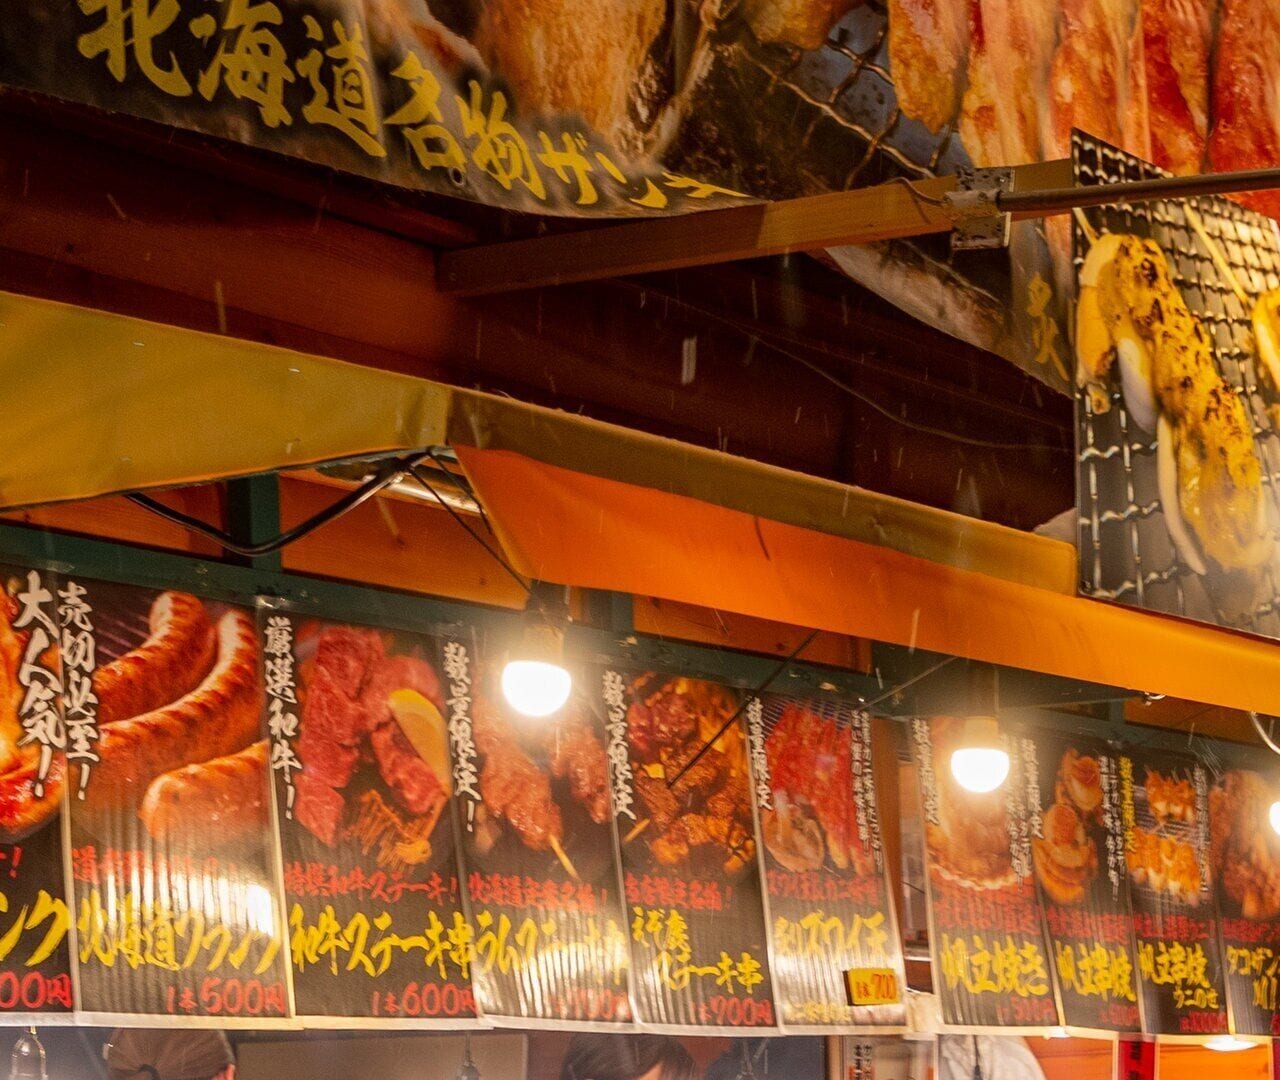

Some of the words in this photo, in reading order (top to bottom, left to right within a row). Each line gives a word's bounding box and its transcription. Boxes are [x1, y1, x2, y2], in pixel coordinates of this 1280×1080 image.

[57, 580, 100, 801] 売切必至!
[289, 902, 475, 981] 和牛ステーキ串
